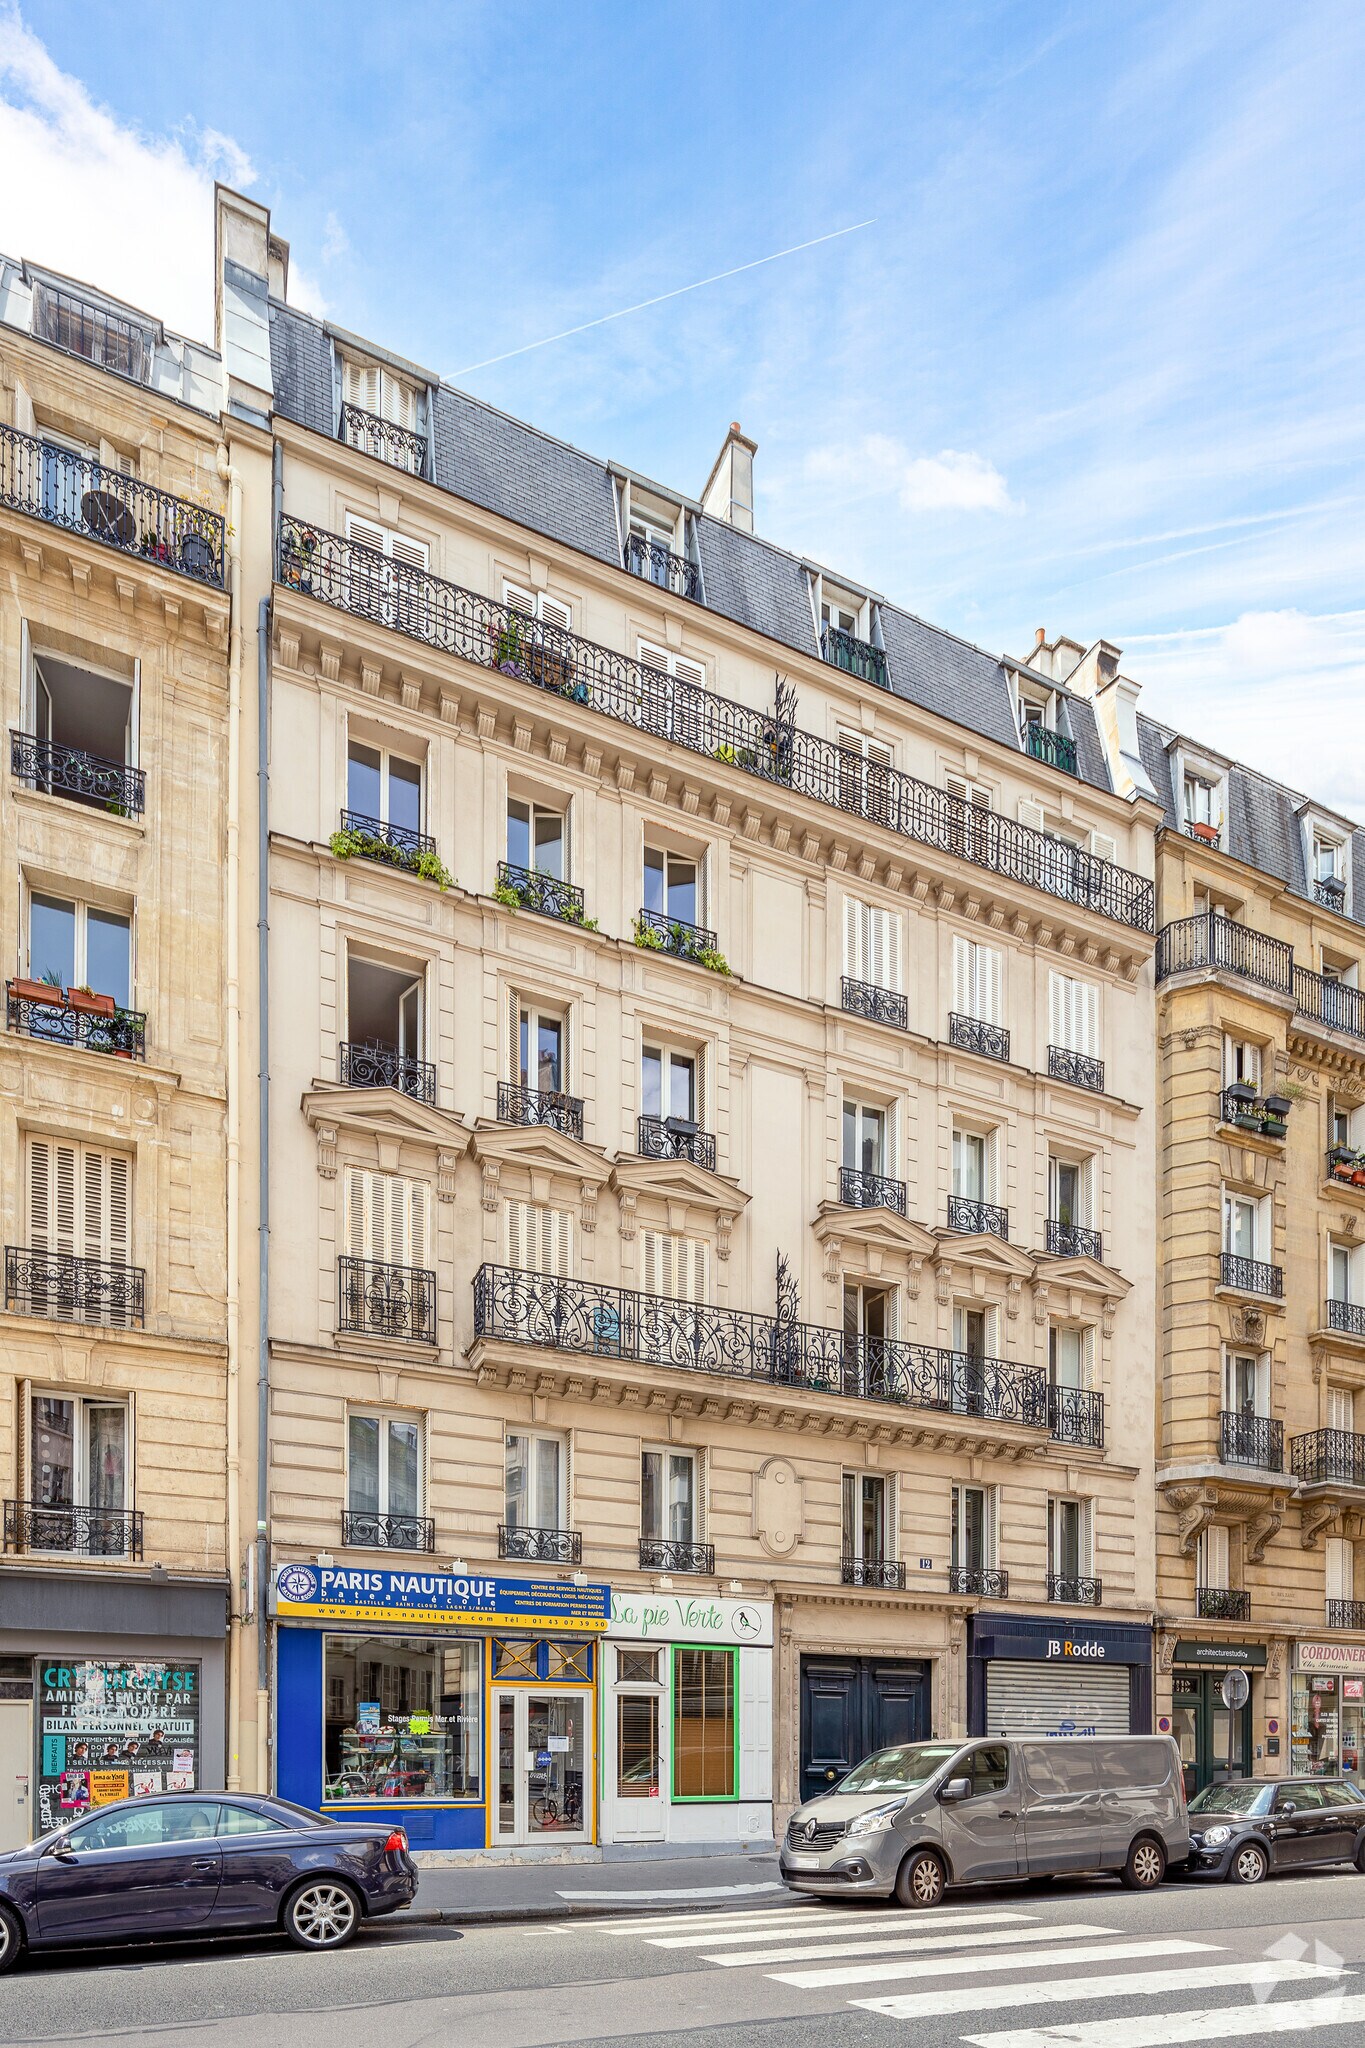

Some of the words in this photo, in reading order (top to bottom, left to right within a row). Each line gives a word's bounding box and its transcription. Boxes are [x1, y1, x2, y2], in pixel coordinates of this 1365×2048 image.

[922, 1559, 930, 1568] 12
[321, 1570, 382, 1591] PARIS
[390, 1575, 496, 1599] NAUTIQUE
[321, 1588, 408, 1602] bateau
[432, 1595, 496, 1606] école
[318, 1608, 493, 1621] www.paris-nautique.com
[611, 1593, 638, 1624] La
[642, 1605, 670, 1636] pie
[676, 1600, 723, 1629] Verte
[1046, 1640, 1060, 1658] JB
[1064, 1641, 1105, 1657] Rodde
[1301, 1646, 1365, 1662] CORDONNER
[166, 1692, 191, 1704] PAR
[388, 1714, 409, 1723] Stages
[46, 1720, 78, 1730] BILAN
[83, 1721, 143, 1731] PERSONNEL
[148, 1722, 191, 1732] GRATUIT
